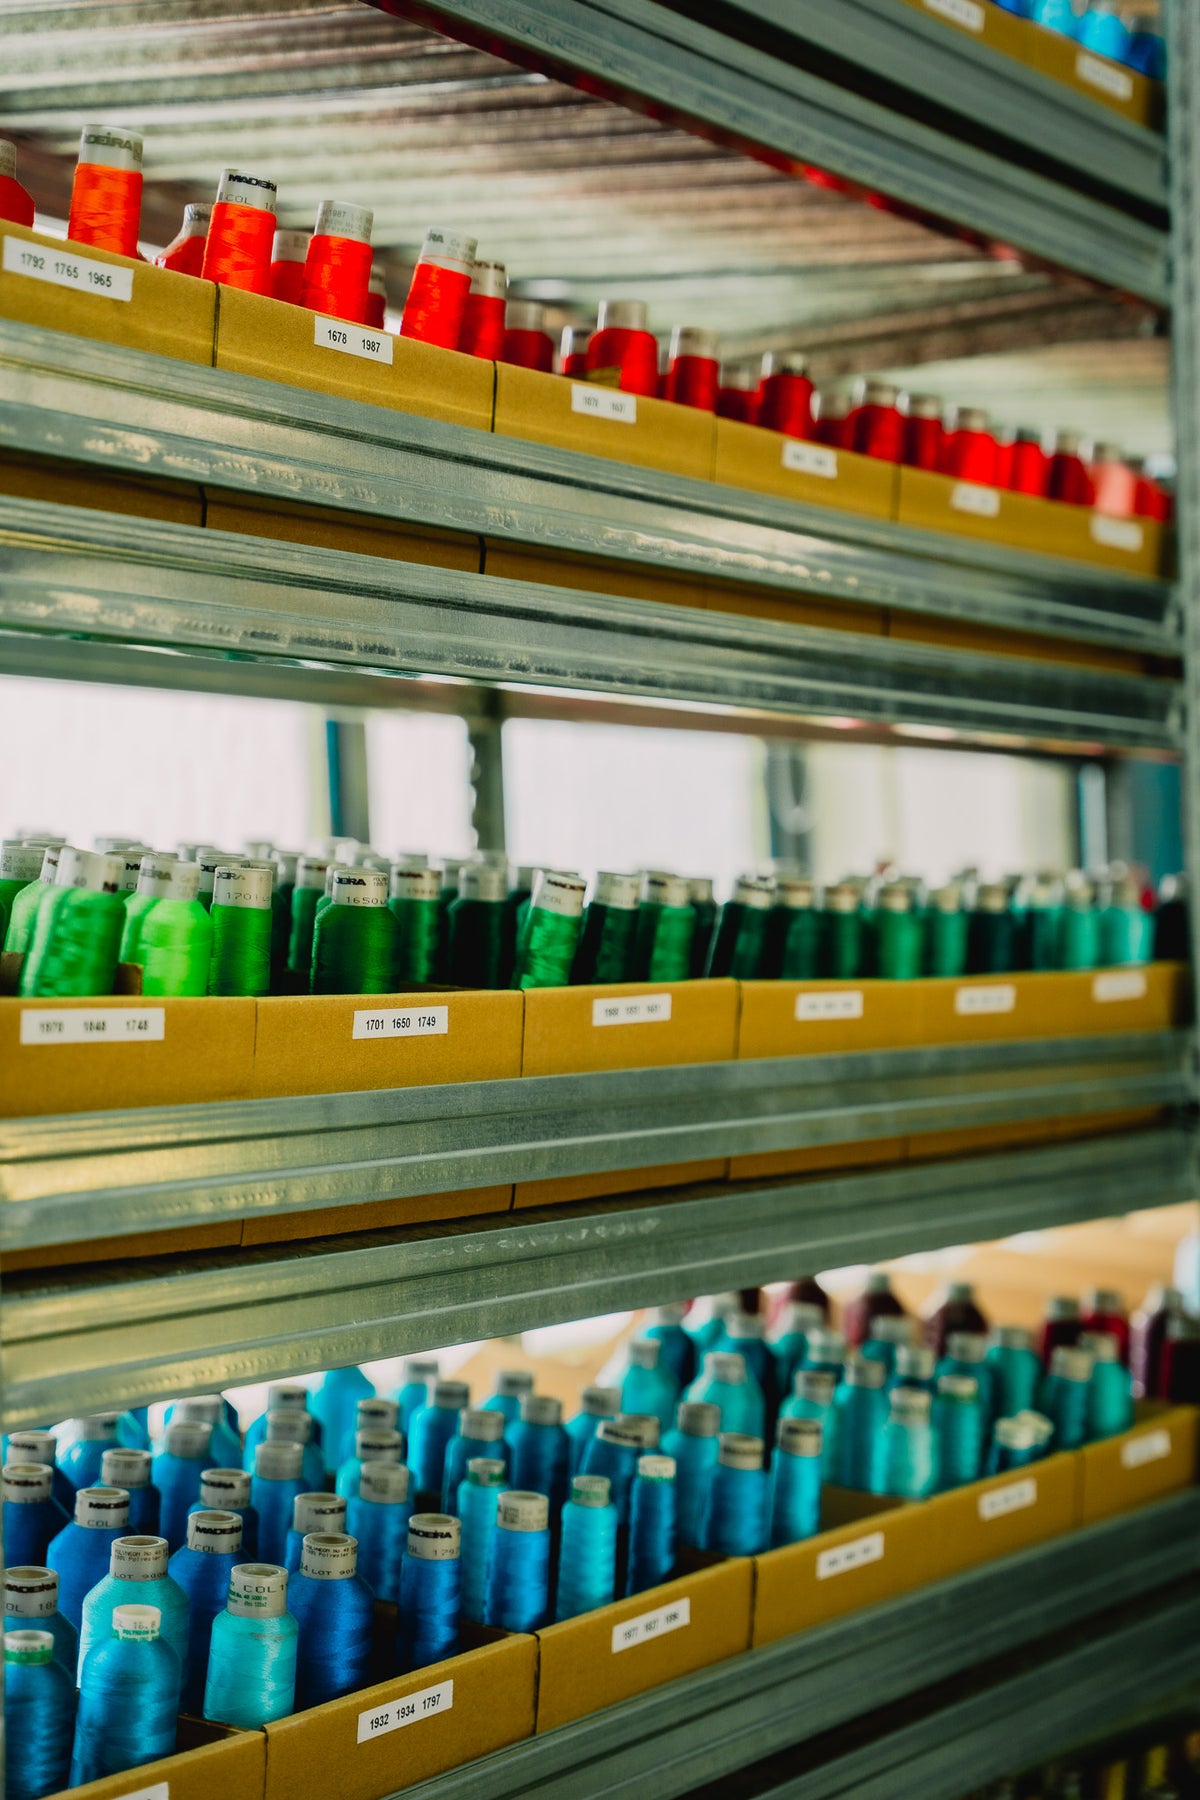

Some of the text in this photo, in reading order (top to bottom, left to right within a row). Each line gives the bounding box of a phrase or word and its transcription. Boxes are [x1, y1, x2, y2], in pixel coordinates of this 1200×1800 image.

[21, 253, 112, 287] 1792 1765 1965
[328, 329, 381, 353] 1678 1987
[366, 1016, 436, 1030] 1701 1650 1749
[114, 1571, 134, 1579] LOT
[311, 1568, 332, 1576] LOT
[243, 1584, 277, 1594] COL
[370, 1694, 441, 1730] 1932 1934 1797
